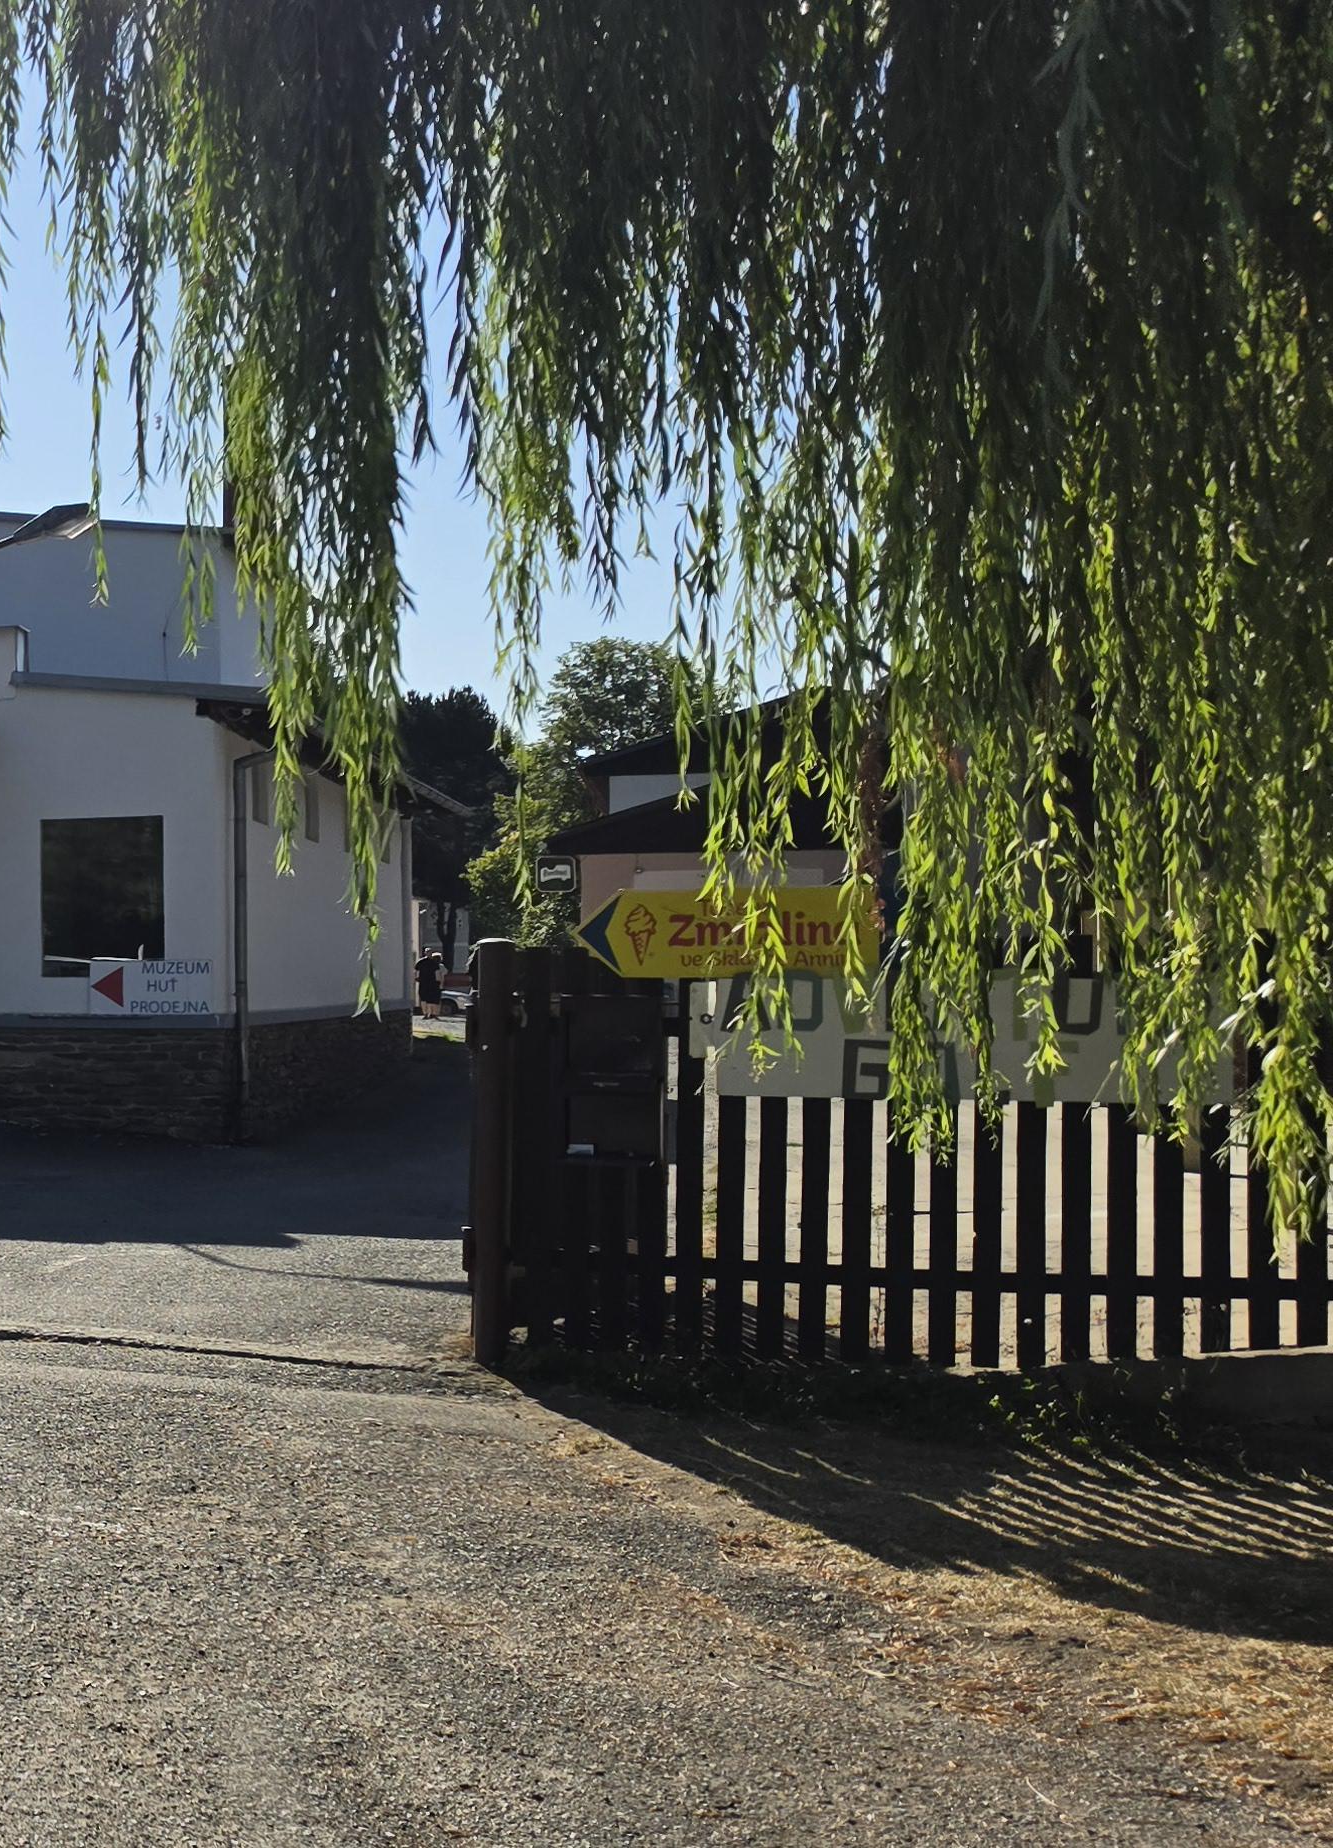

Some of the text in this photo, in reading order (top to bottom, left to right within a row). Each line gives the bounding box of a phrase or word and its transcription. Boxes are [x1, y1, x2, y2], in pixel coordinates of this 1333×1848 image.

[141, 961, 210, 975] MUZEUM
[680, 955, 703, 968] ve
[130, 1000, 210, 1014] PRODEJNA
